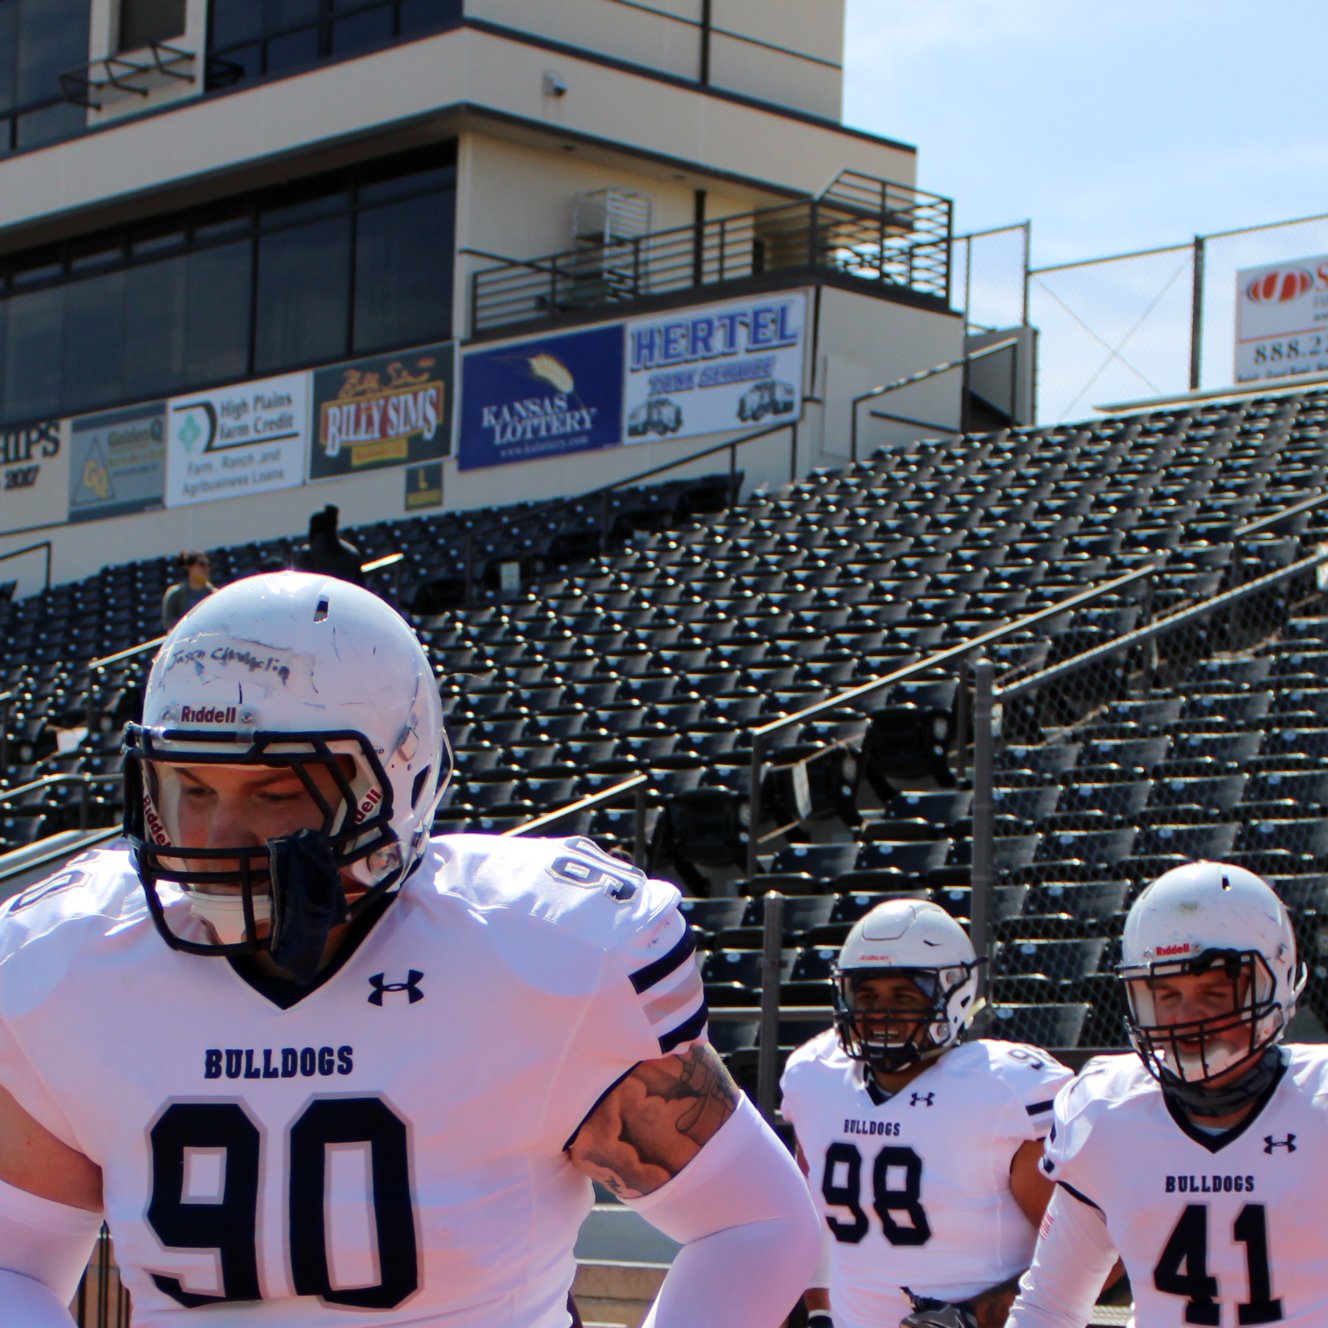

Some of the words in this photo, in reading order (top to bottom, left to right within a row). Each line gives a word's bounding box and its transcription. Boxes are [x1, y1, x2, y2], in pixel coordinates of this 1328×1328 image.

[630, 304, 799, 372] HERTEL
[220, 397, 249, 421] High
[254, 391, 292, 412] Plains
[325, 398, 385, 458] BILLY
[387, 387, 439, 441] SIMS
[482, 393, 568, 428] KANSAS
[220, 421, 249, 440] Farm
[253, 410, 294, 434] Credit
[494, 408, 593, 446] LOTTERY
[181, 704, 237, 724] Riddell
[1156, 943, 1190, 958] Riddell
[203, 1048, 355, 1081] BULLDOGS
[843, 1118, 902, 1137] BULLDOGS
[821, 1141, 933, 1246] 98
[1165, 1175, 1256, 1194] BULLDOGS
[145, 1093, 424, 1312] 90
[1151, 1201, 1286, 1328] 41
